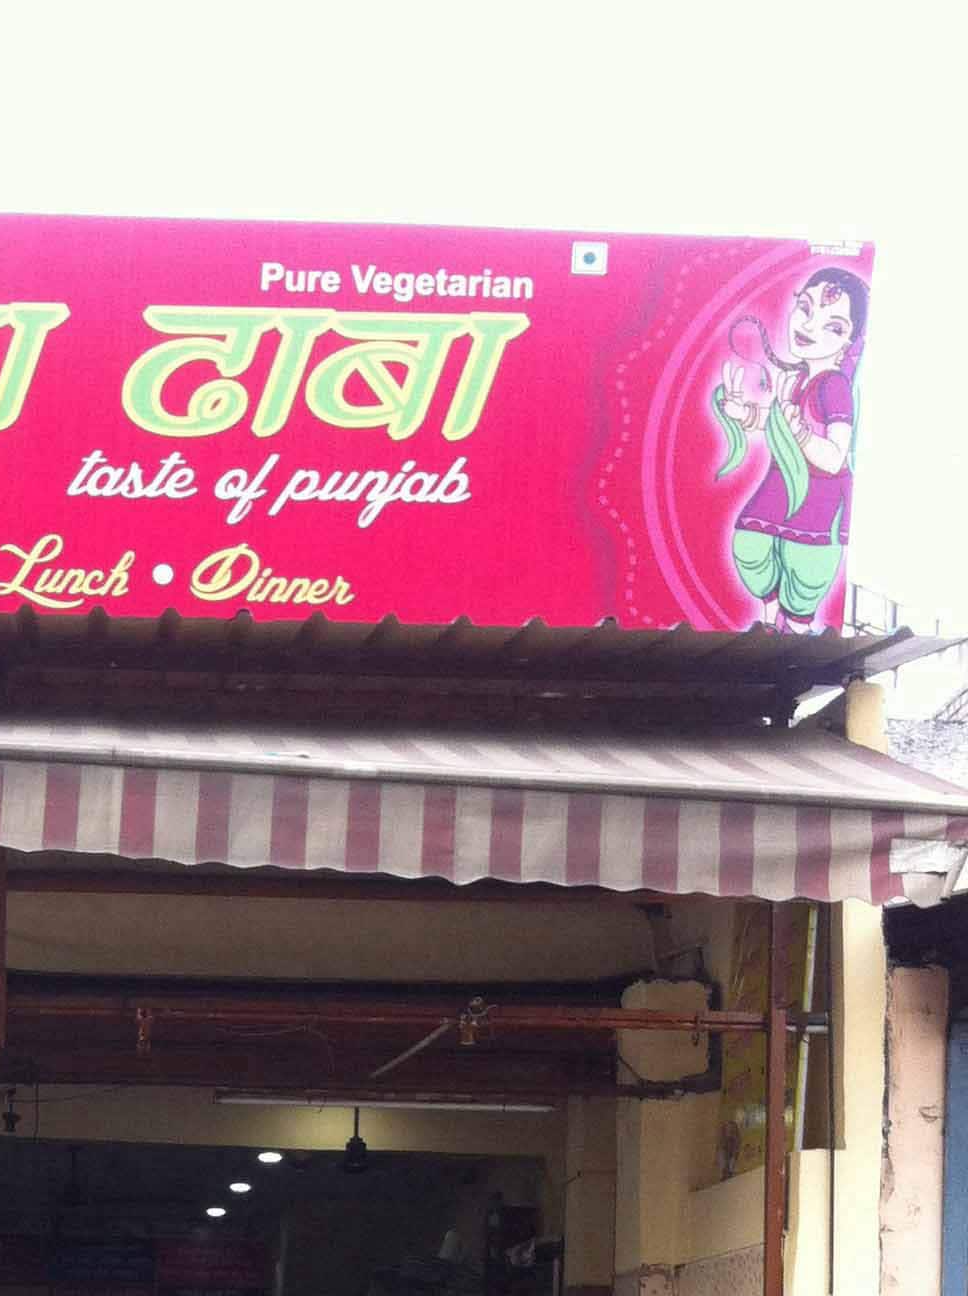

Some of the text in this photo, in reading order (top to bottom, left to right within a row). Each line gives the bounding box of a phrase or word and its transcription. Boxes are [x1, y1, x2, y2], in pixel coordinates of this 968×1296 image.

[260, 262, 534, 303] Pure Vegetarian
[121, 304, 532, 441] ढाबा
[67, 450, 471, 529] taste of punjab
[190, 543, 355, 605] Dinner
